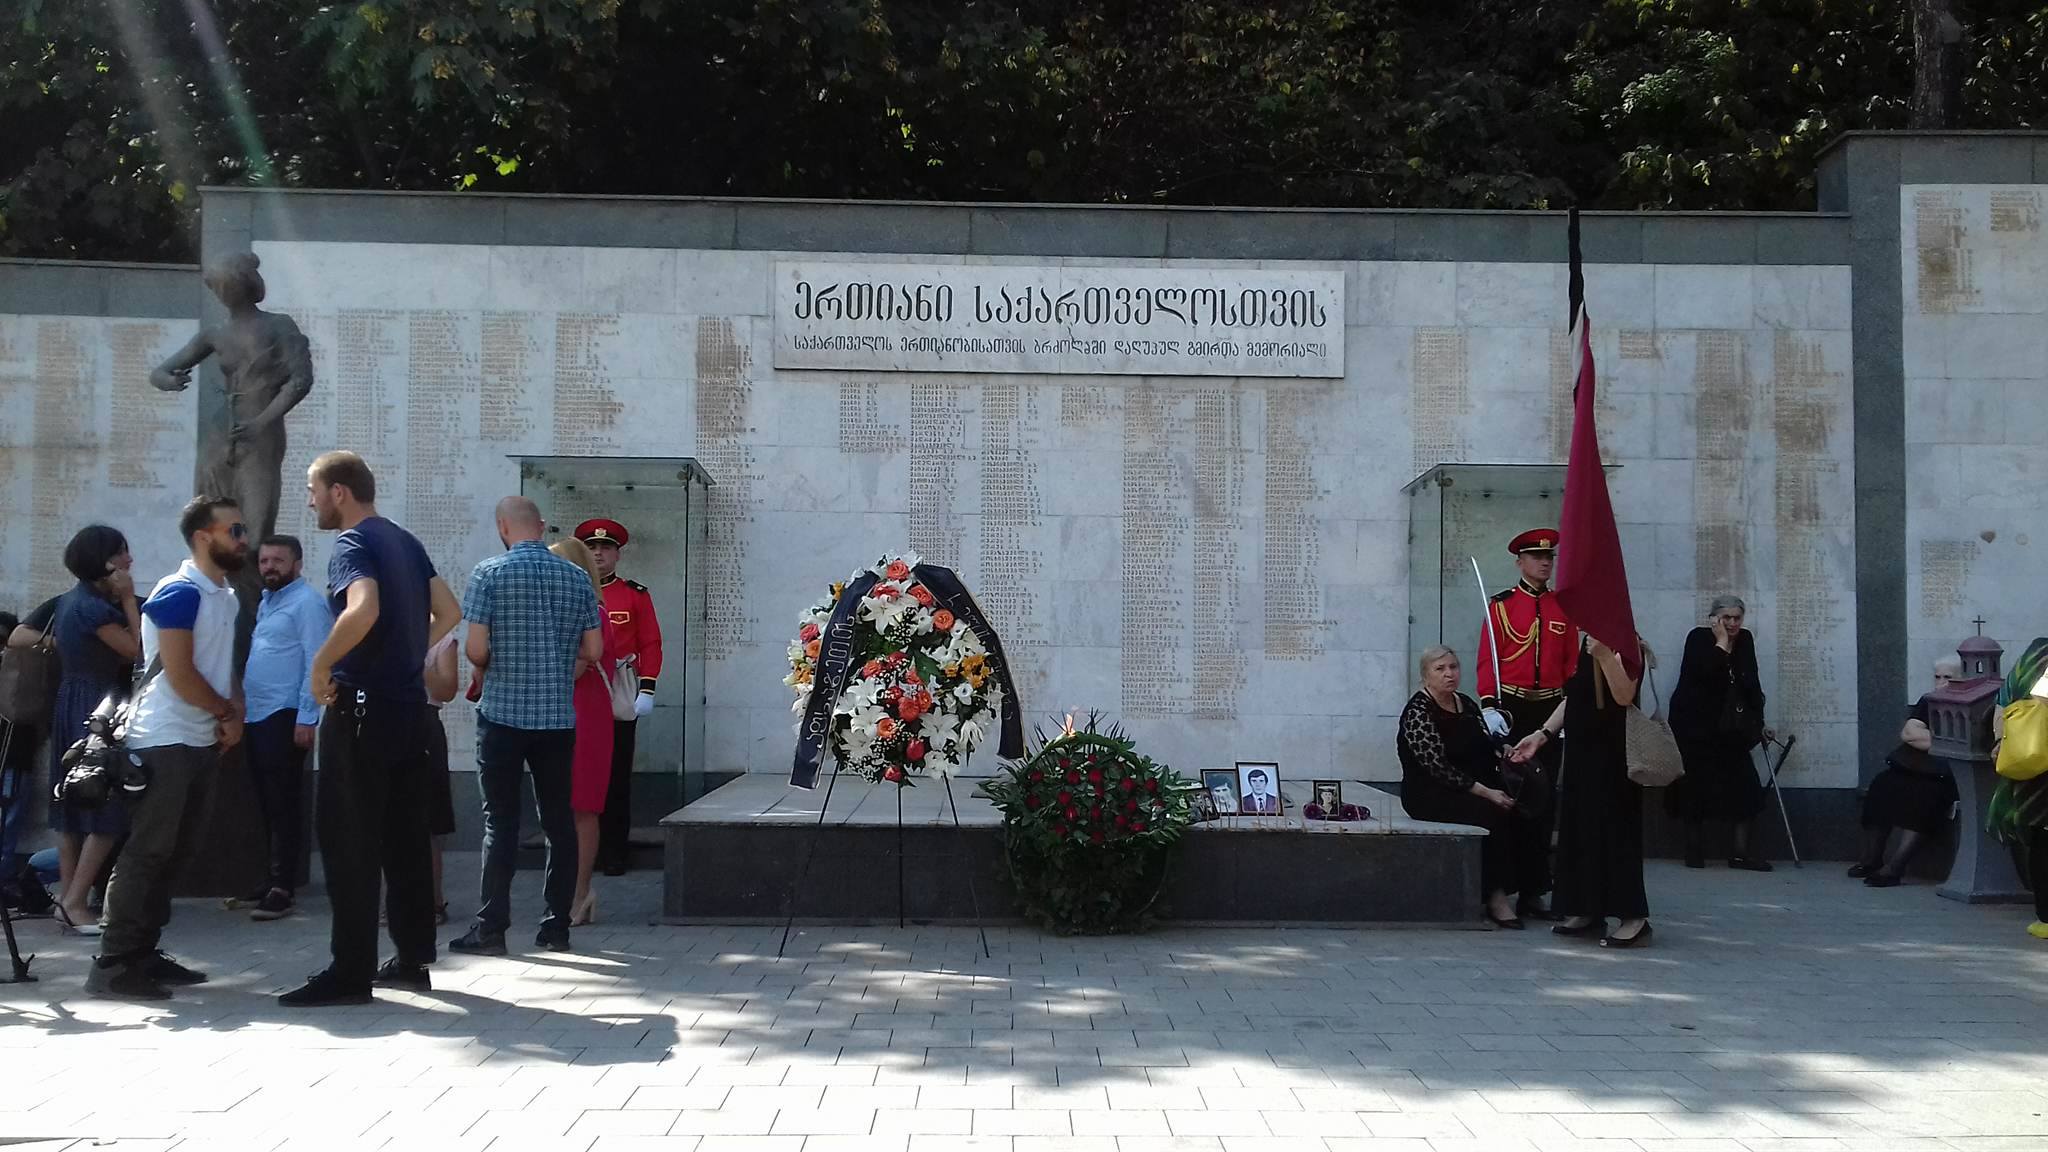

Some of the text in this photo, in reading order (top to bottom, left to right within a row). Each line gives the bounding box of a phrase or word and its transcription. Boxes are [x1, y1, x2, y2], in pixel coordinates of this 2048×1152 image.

[794, 281, 1327, 328] ერთიანი საქართველოსთვის
[794, 335, 1327, 359] საქართველოს ერთიანობისათვის ბრძოლაში დაღუპულ გმირთა მემორიალი
